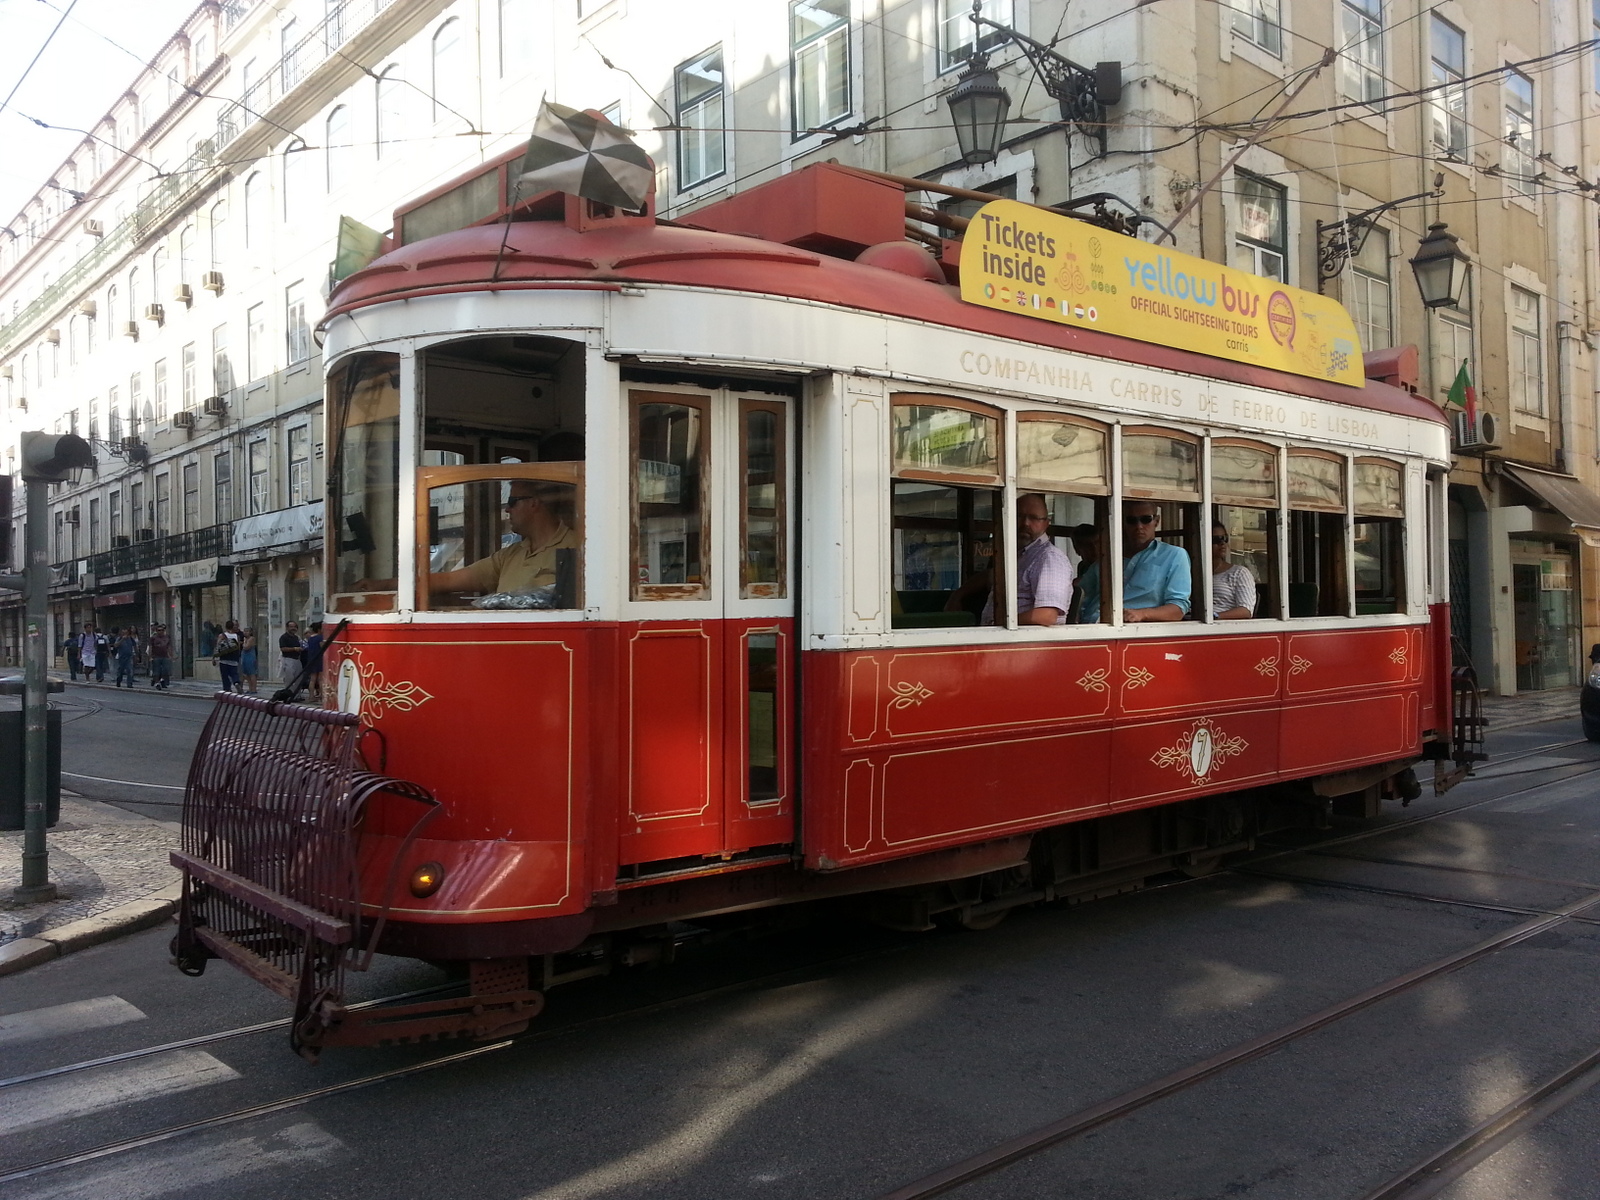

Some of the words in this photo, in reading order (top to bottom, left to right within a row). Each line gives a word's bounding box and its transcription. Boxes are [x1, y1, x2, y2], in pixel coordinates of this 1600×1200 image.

[981, 213, 1056, 259] Tickets
[983, 244, 1046, 287] inside
[1130, 295, 1172, 318] OFFICIAL
[1173, 306, 1230, 332] SIGHTSEEING
[1231, 320, 1259, 339] TOURS
[1221, 273, 1260, 318] bus
[1226, 339, 1249, 352] carris
[959, 349, 1094, 392] COMPANHIA
[1109, 377, 1184, 407] CARRIS
[1197, 392, 1219, 414] DE
[1232, 399, 1287, 424] FERRO
[1300, 411, 1318, 429] DE
[1327, 418, 1379, 440] LISBOA
